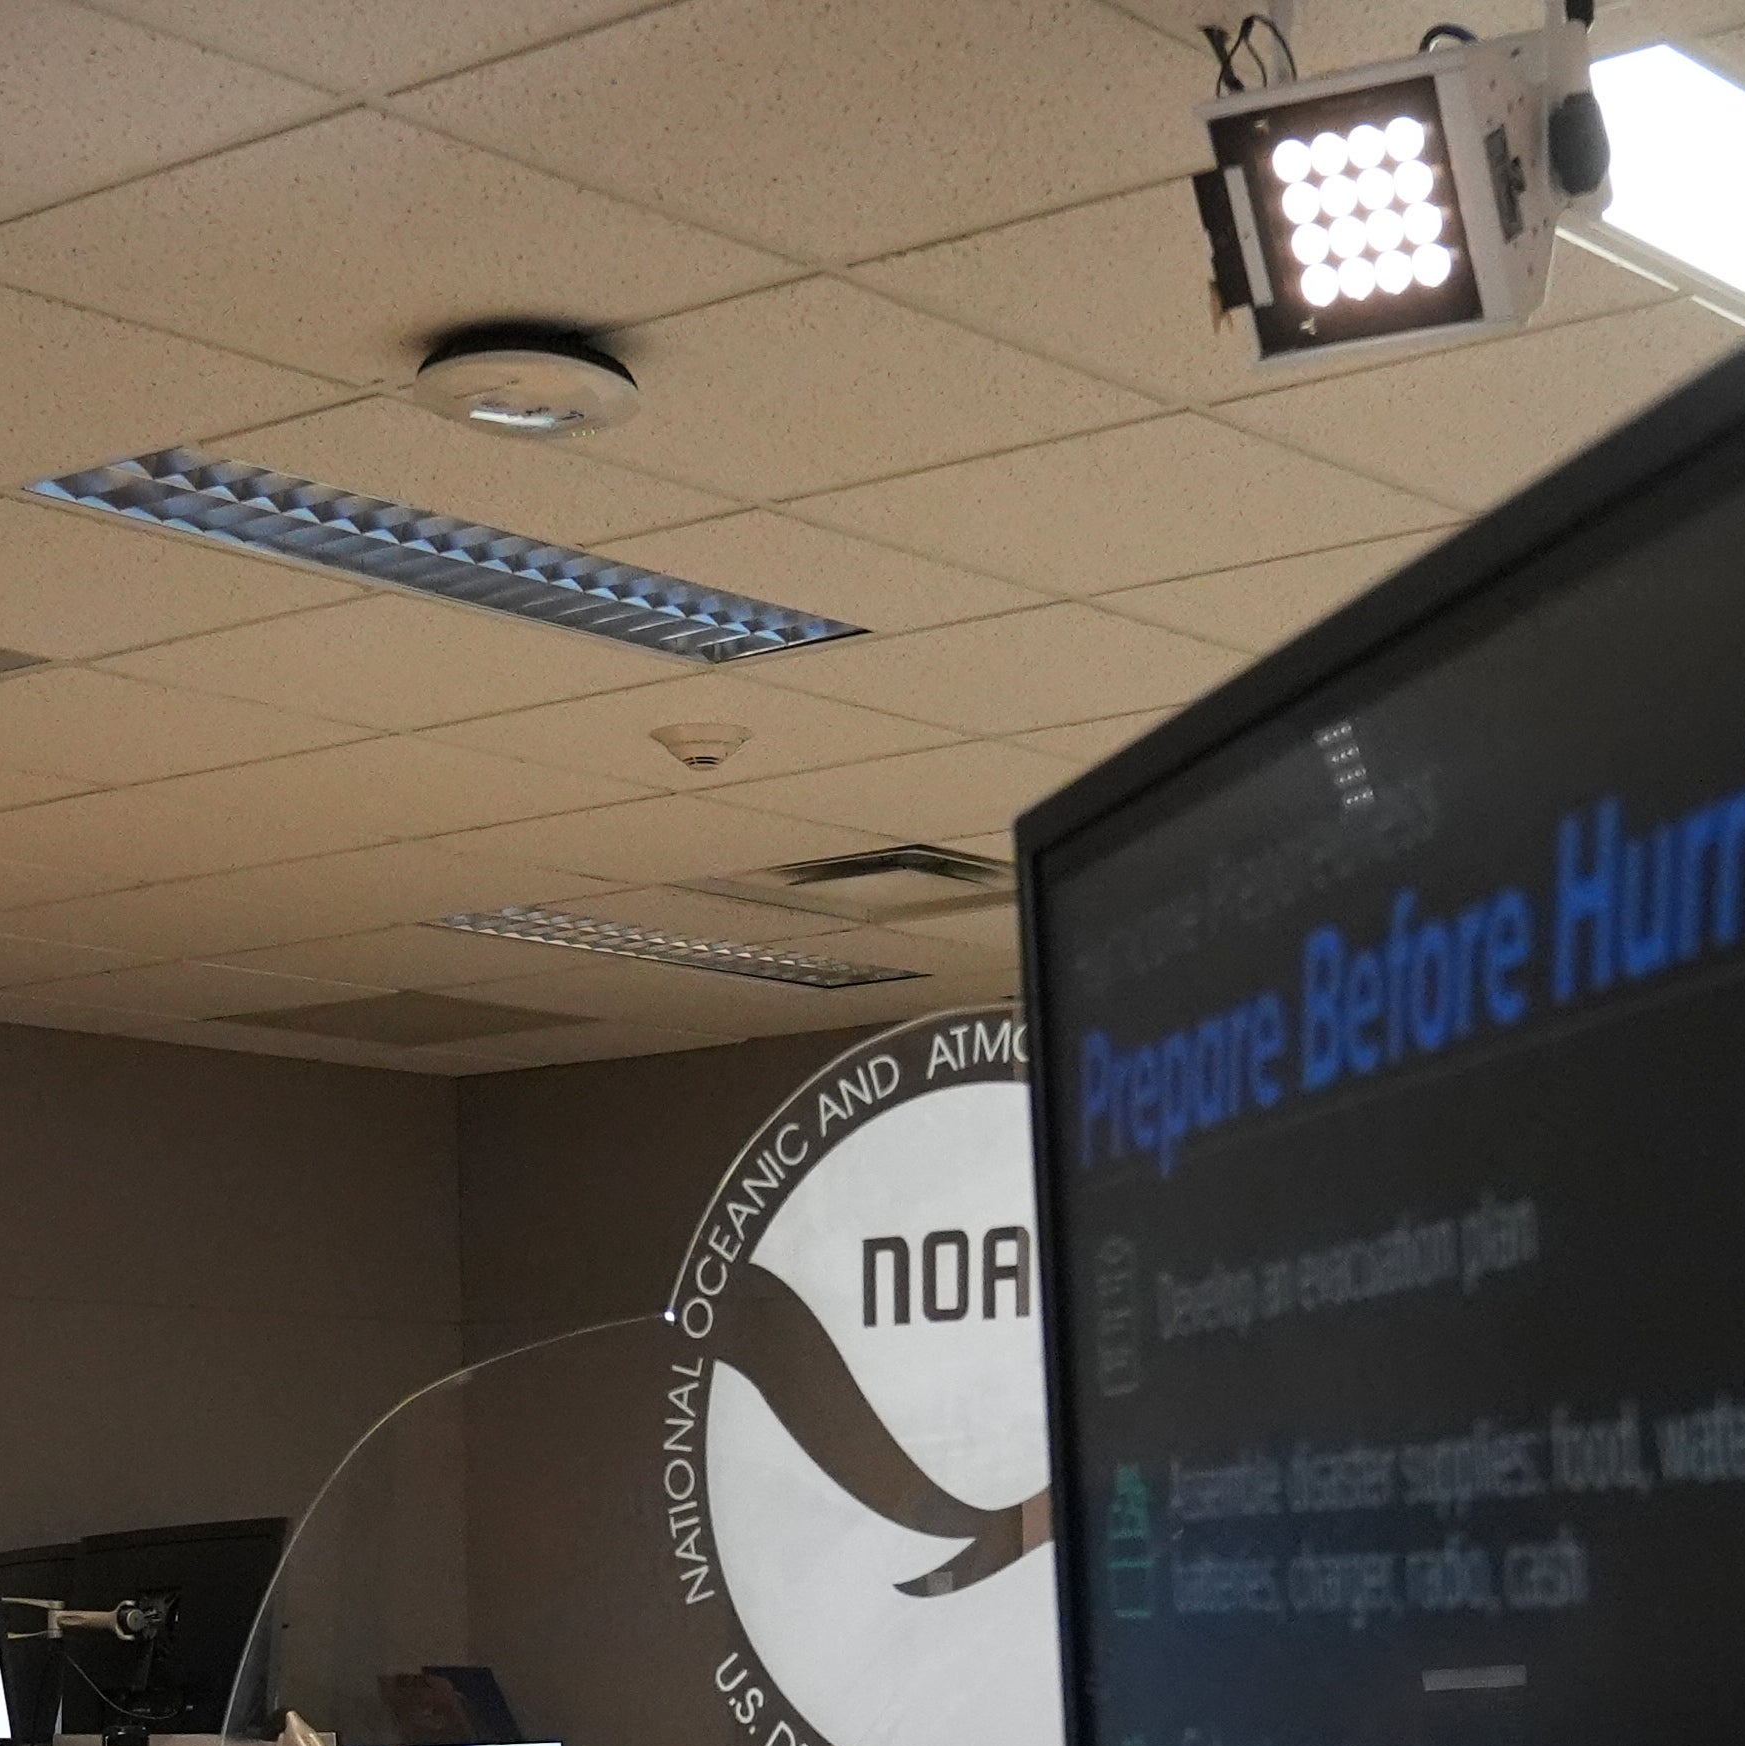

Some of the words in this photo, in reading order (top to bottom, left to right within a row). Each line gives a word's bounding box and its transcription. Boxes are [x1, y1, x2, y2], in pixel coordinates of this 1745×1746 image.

[1079, 990, 1288, 1174] Prepare
[1300, 882, 1532, 1090] Before
[817, 1054, 902, 1137] AND
[682, 1122, 809, 1340] OCEANIC
[1459, 1191, 1540, 1296] plan
[664, 1357, 714, 1606] NATIONAL
[1549, 1400, 1650, 1496] food,
[1502, 1521, 1592, 1613] cash
[714, 1652, 757, 1736] U.S.
